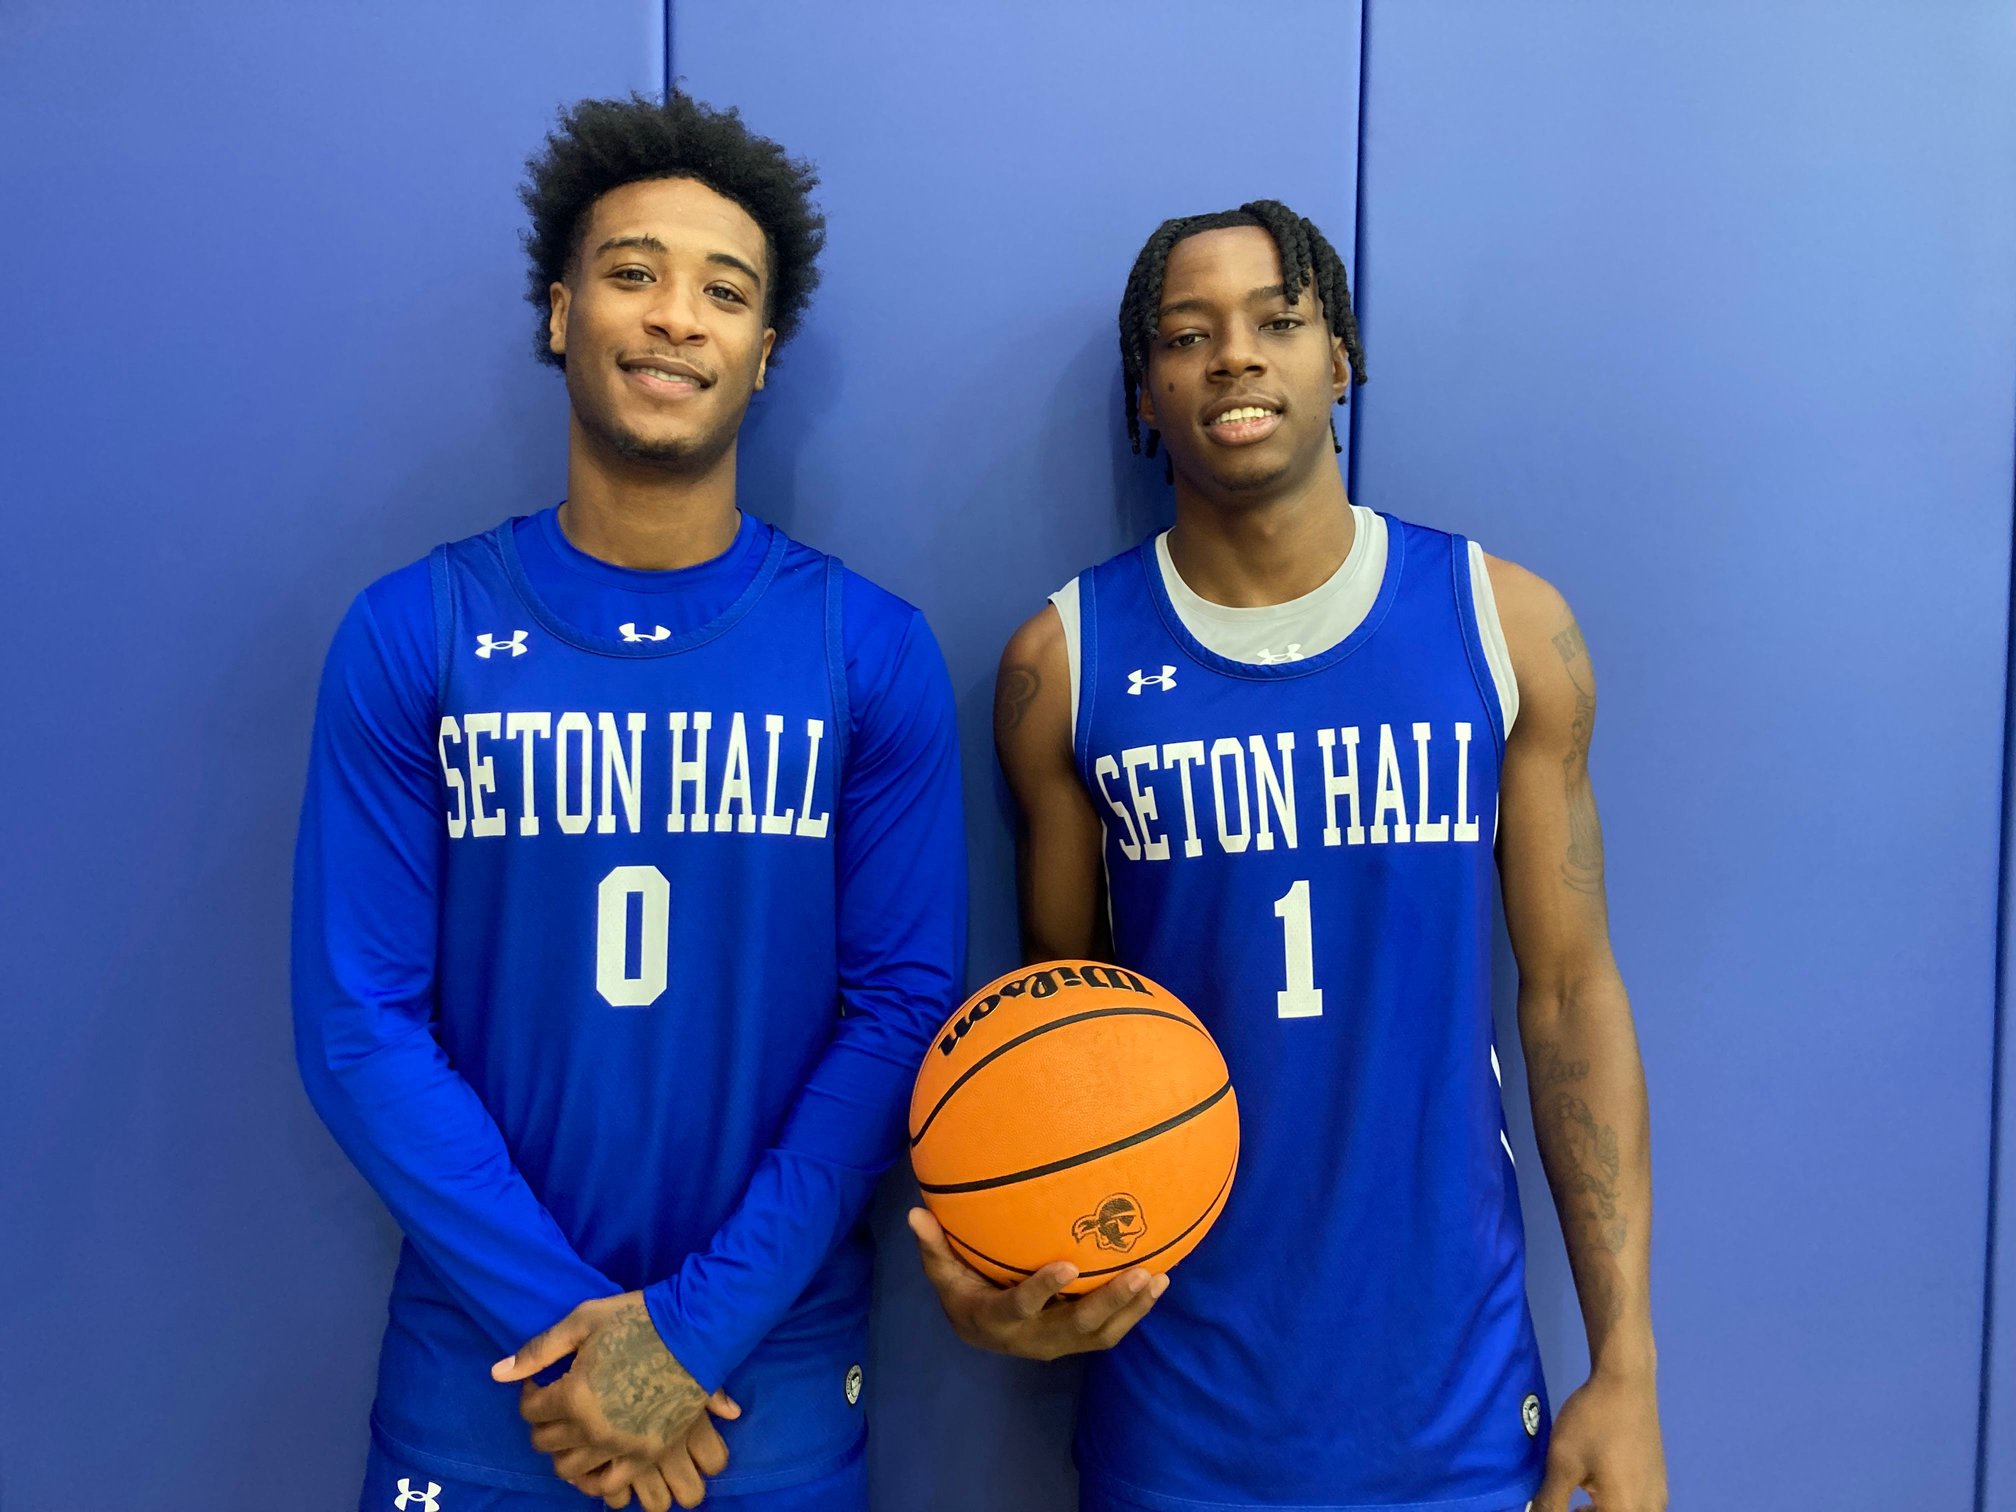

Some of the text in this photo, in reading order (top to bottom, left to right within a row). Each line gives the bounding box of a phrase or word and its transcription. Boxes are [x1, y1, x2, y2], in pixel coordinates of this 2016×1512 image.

[438, 711, 830, 839] SETON HALL
[1095, 721, 1480, 861] SETON HALL
[596, 866, 671, 1007] 0
[1273, 880, 1323, 1019] 1
[937, 965, 1155, 1057] Wilson
